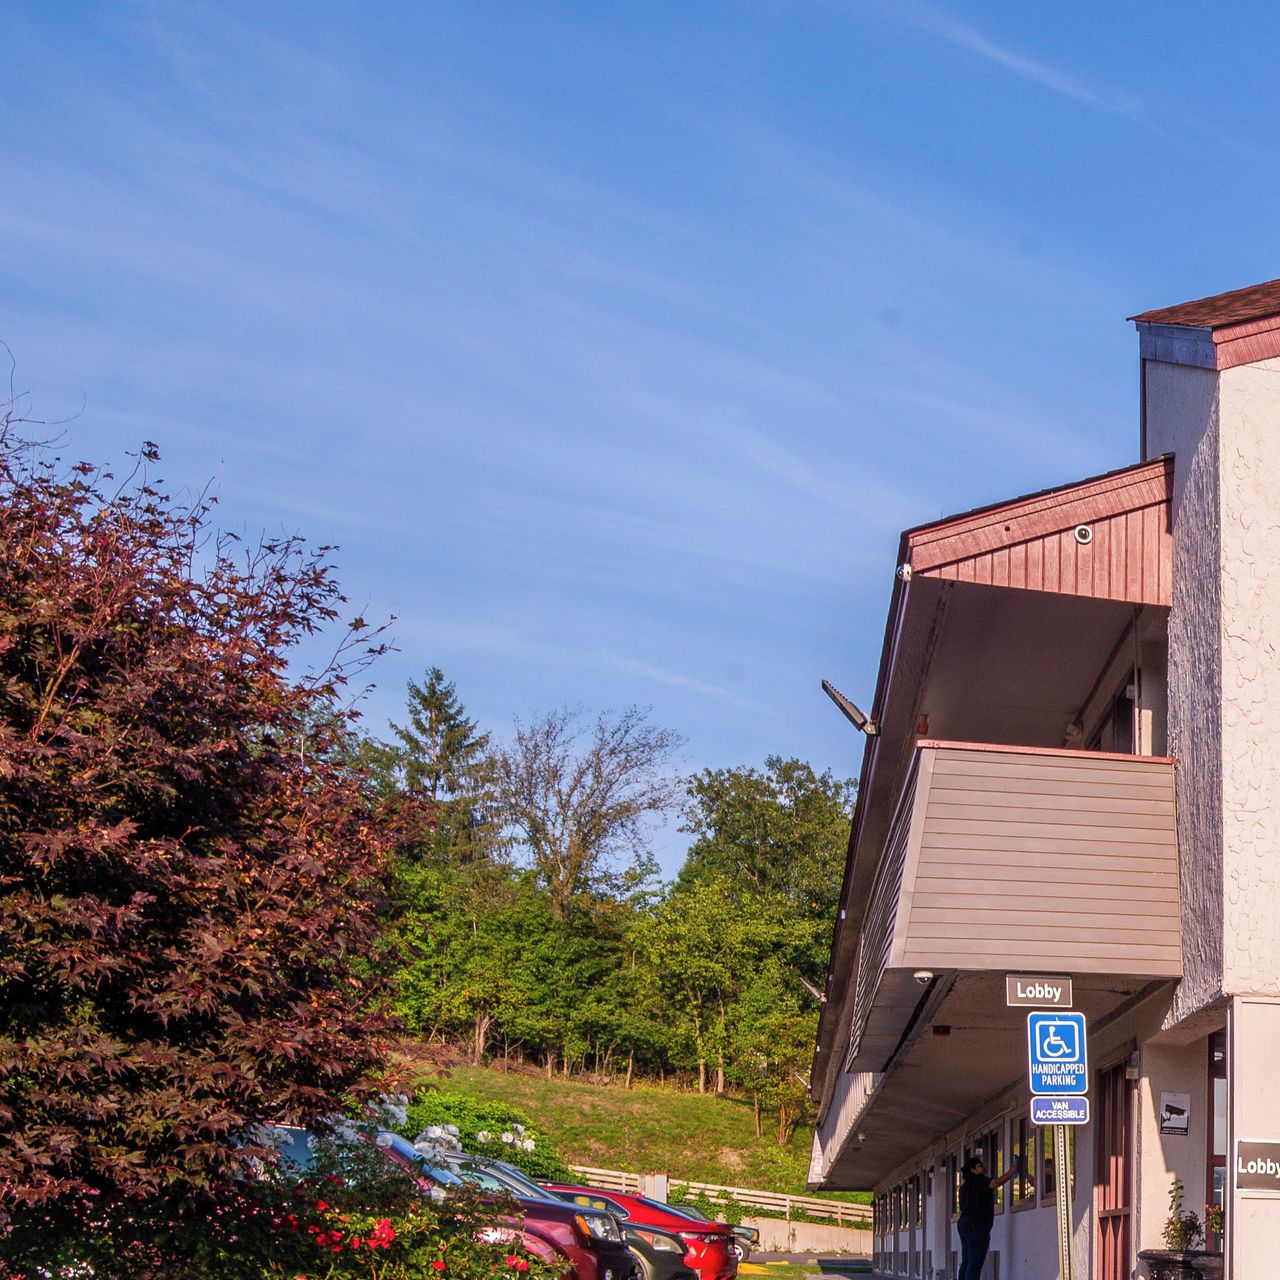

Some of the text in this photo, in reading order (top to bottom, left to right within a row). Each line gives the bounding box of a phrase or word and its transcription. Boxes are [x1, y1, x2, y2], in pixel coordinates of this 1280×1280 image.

[1017, 982, 1062, 1002] Lobby
[1032, 1063, 1085, 1075] HANDICAPPED
[1041, 1074, 1077, 1086] PARKING
[1051, 1101, 1069, 1110] VAN
[1035, 1109, 1085, 1119] ACCESSIBLE
